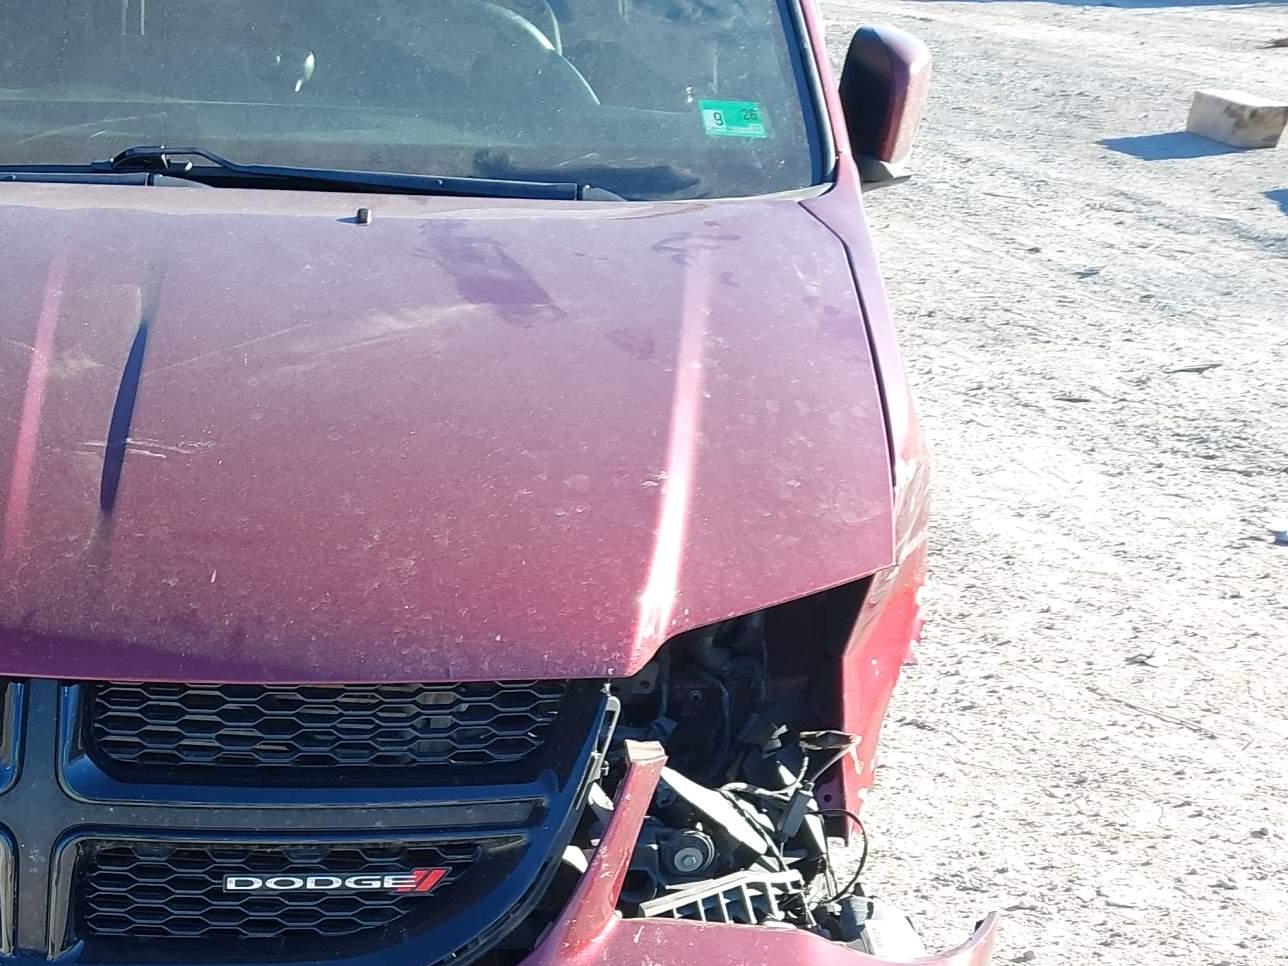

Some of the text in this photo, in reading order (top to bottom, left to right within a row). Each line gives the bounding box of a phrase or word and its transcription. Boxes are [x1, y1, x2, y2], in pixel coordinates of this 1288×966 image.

[713, 108, 758, 126] 9 26
[226, 875, 418, 890] DODGE
